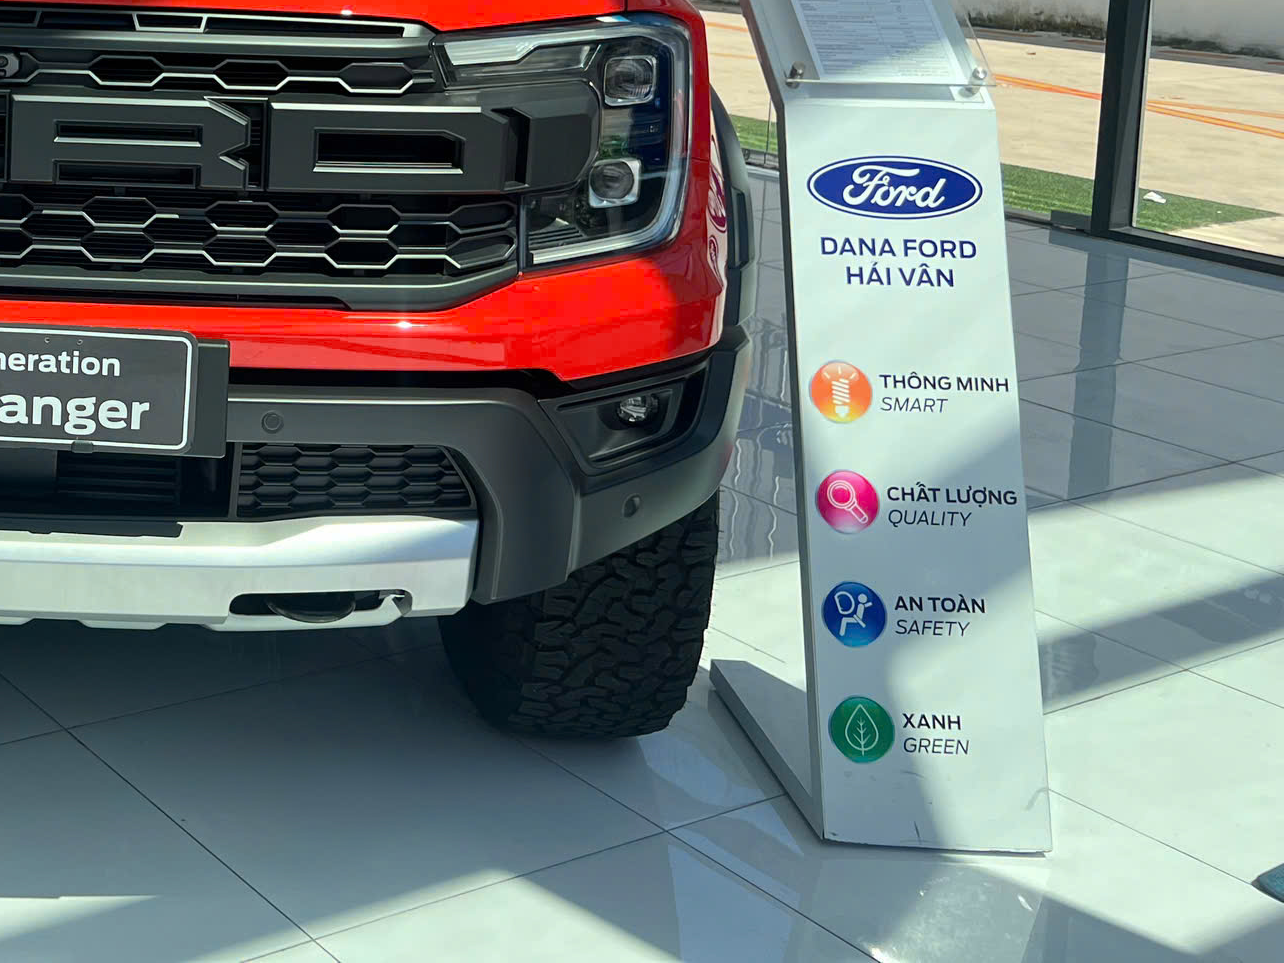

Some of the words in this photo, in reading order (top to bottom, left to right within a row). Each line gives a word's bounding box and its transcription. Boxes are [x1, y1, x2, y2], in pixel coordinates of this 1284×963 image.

[842, 164, 947, 209] Ford
[820, 236, 897, 257] DANA
[903, 239, 977, 259] FORD
[898, 262, 955, 287] VÂN
[879, 371, 952, 391] THÔNG
[956, 377, 1009, 392] MINH
[880, 396, 948, 413] SMART
[887, 481, 941, 503] CHẤT
[945, 485, 1017, 508] LƯỢNG
[888, 509, 972, 527] QUALITY
[894, 596, 924, 612] AN
[927, 593, 986, 614] TOÀN
[895, 619, 970, 637] SAFETY
[902, 713, 962, 730] XANH
[903, 737, 970, 755] GREEN
